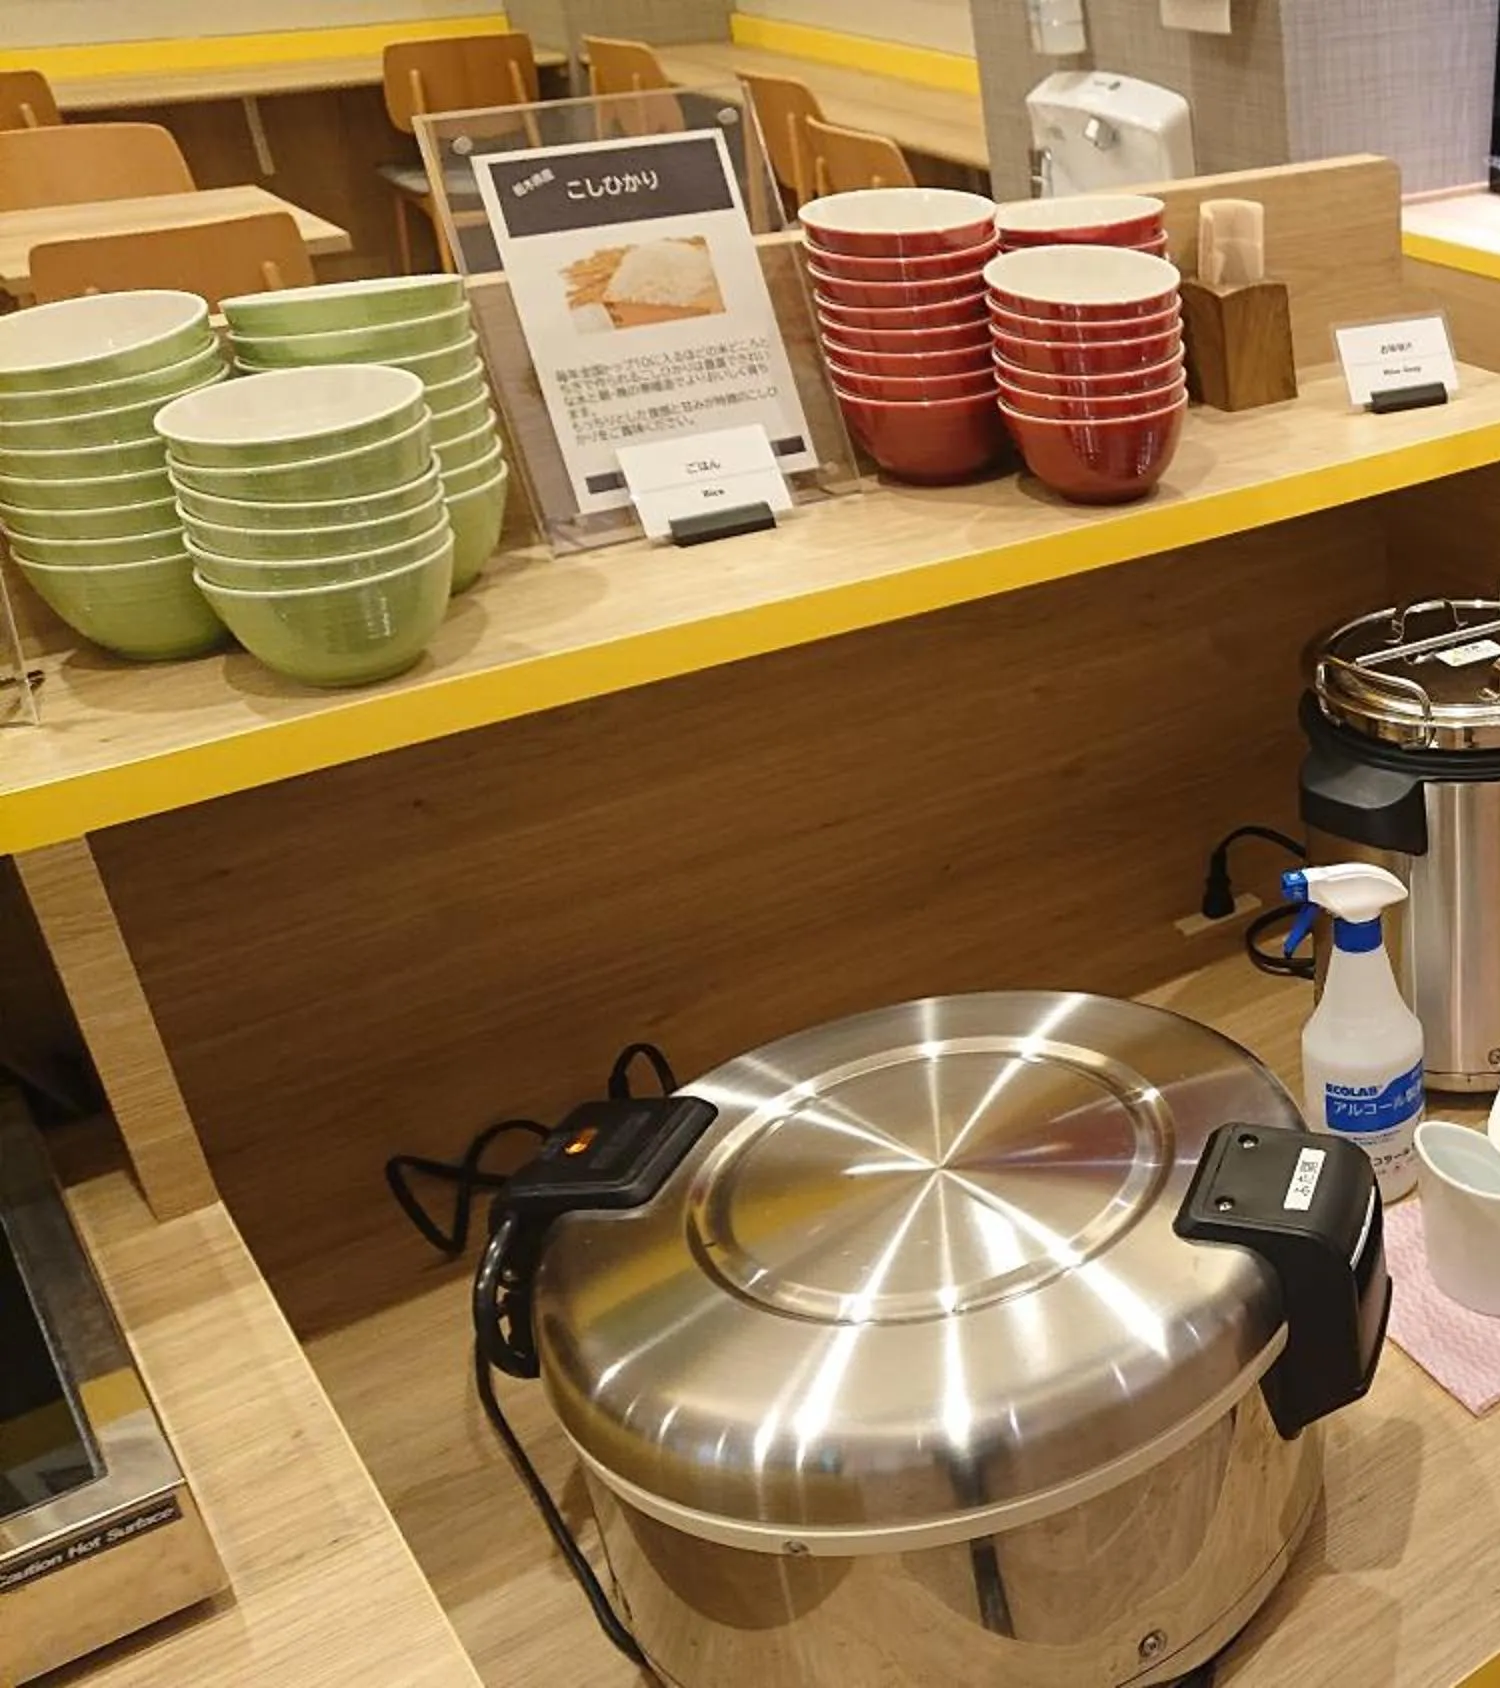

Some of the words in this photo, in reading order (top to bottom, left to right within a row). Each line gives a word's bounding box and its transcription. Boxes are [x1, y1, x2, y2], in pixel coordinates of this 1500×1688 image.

[567, 169, 659, 199] こしひかり
[686, 460, 721, 474] ごはん
[1326, 1083, 1377, 1097] ECOLAB
[67, 1535, 101, 1558] Hot
[107, 1507, 174, 1541] Surface
